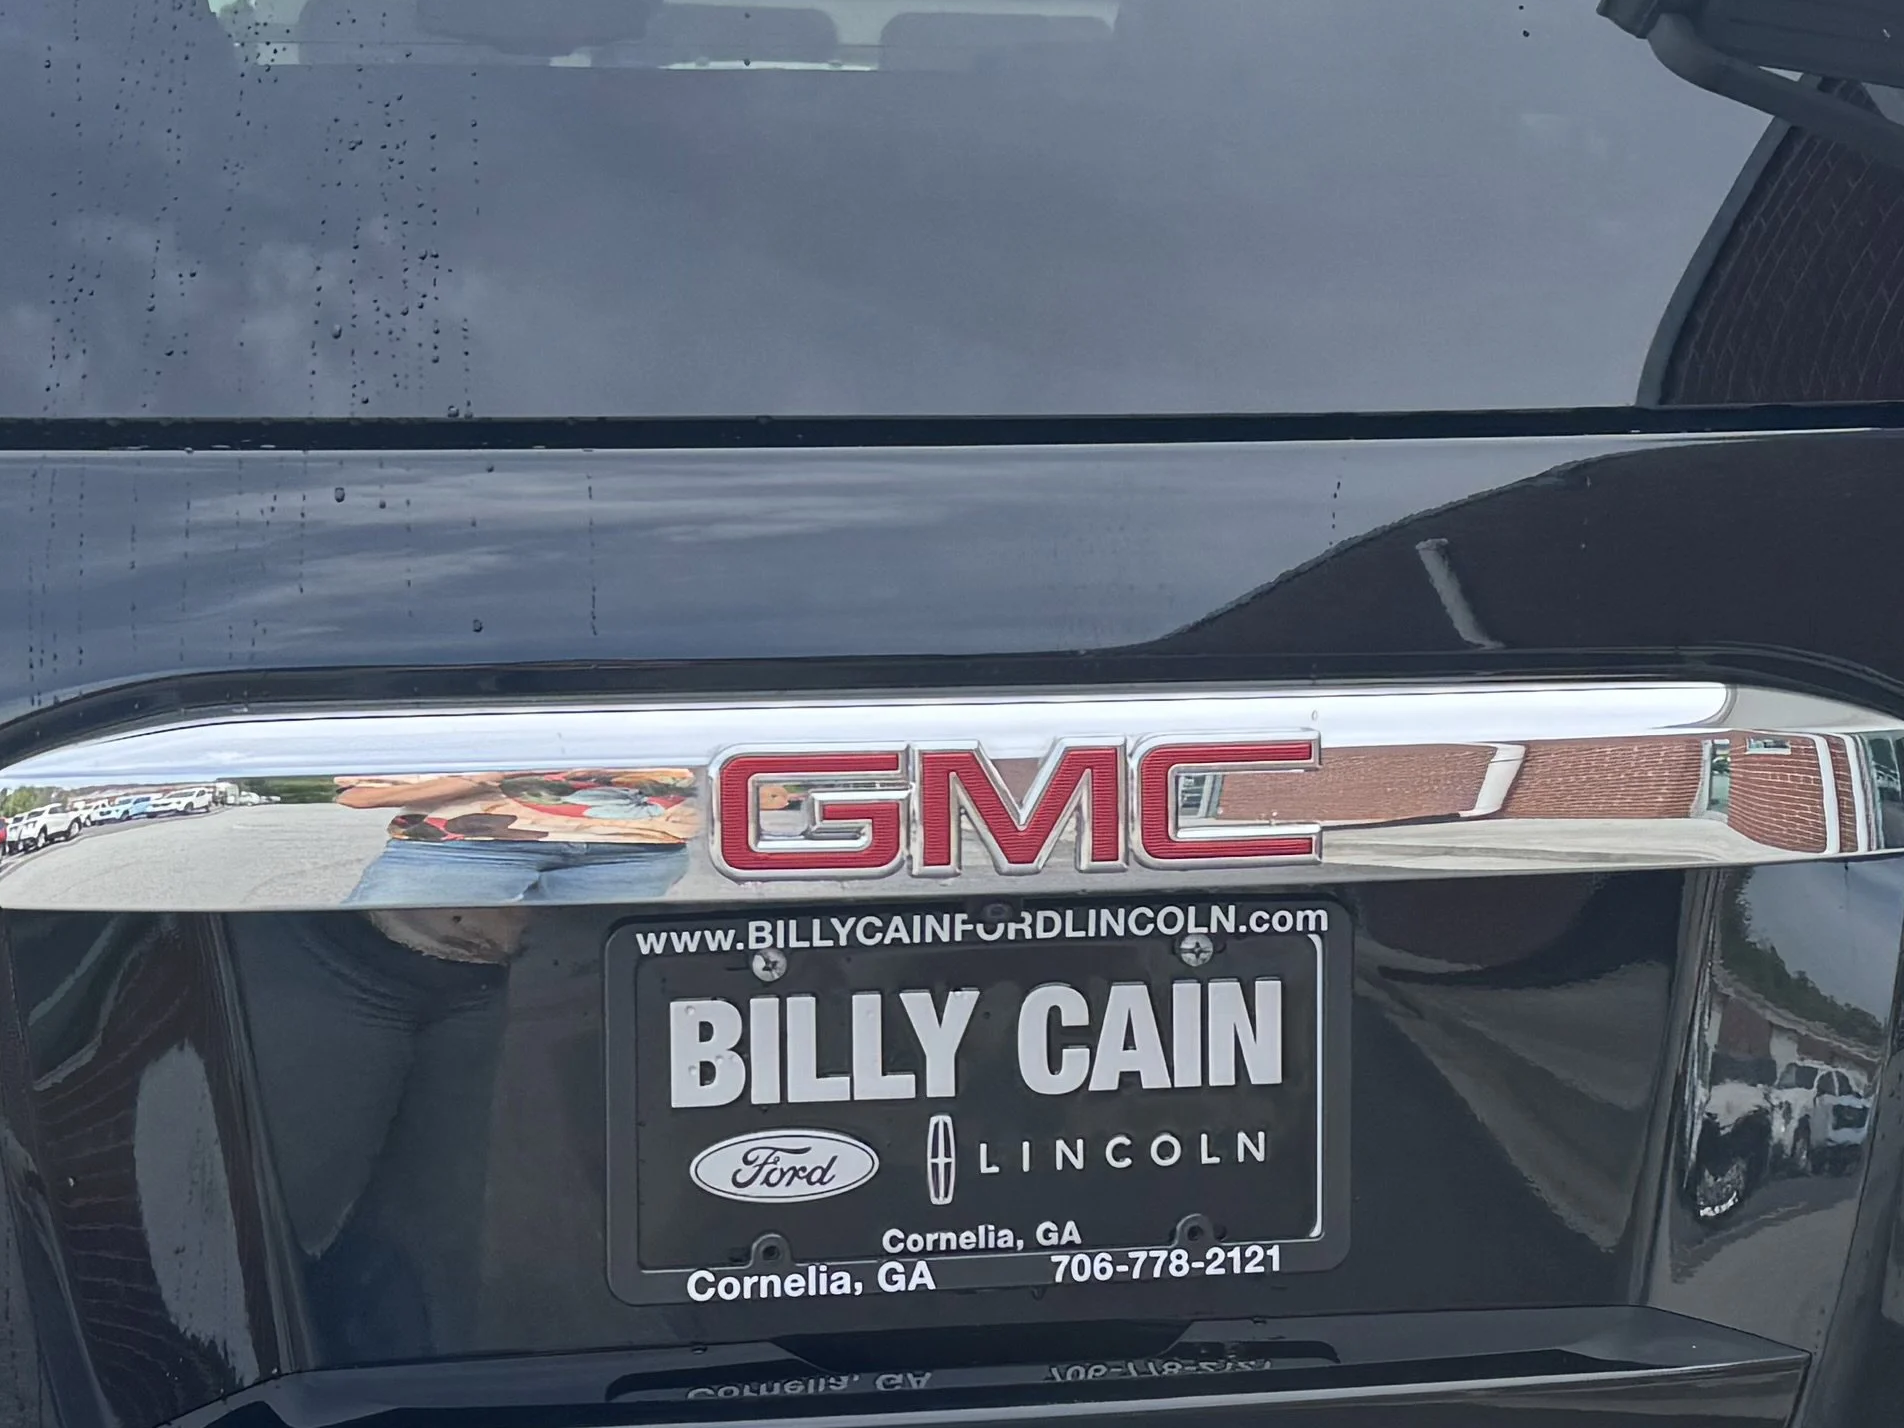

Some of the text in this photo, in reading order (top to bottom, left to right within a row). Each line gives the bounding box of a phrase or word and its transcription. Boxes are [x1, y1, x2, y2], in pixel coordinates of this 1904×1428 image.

[709, 731, 1323, 881] GMC
[669, 978, 1284, 1109] BILLY CAIN
[730, 1129, 1268, 1191] Ford LINCOLN
[881, 1221, 1083, 1255] Cornelia, GA
[686, 1244, 1282, 1304] Cornelia, GA 706-778-2121
